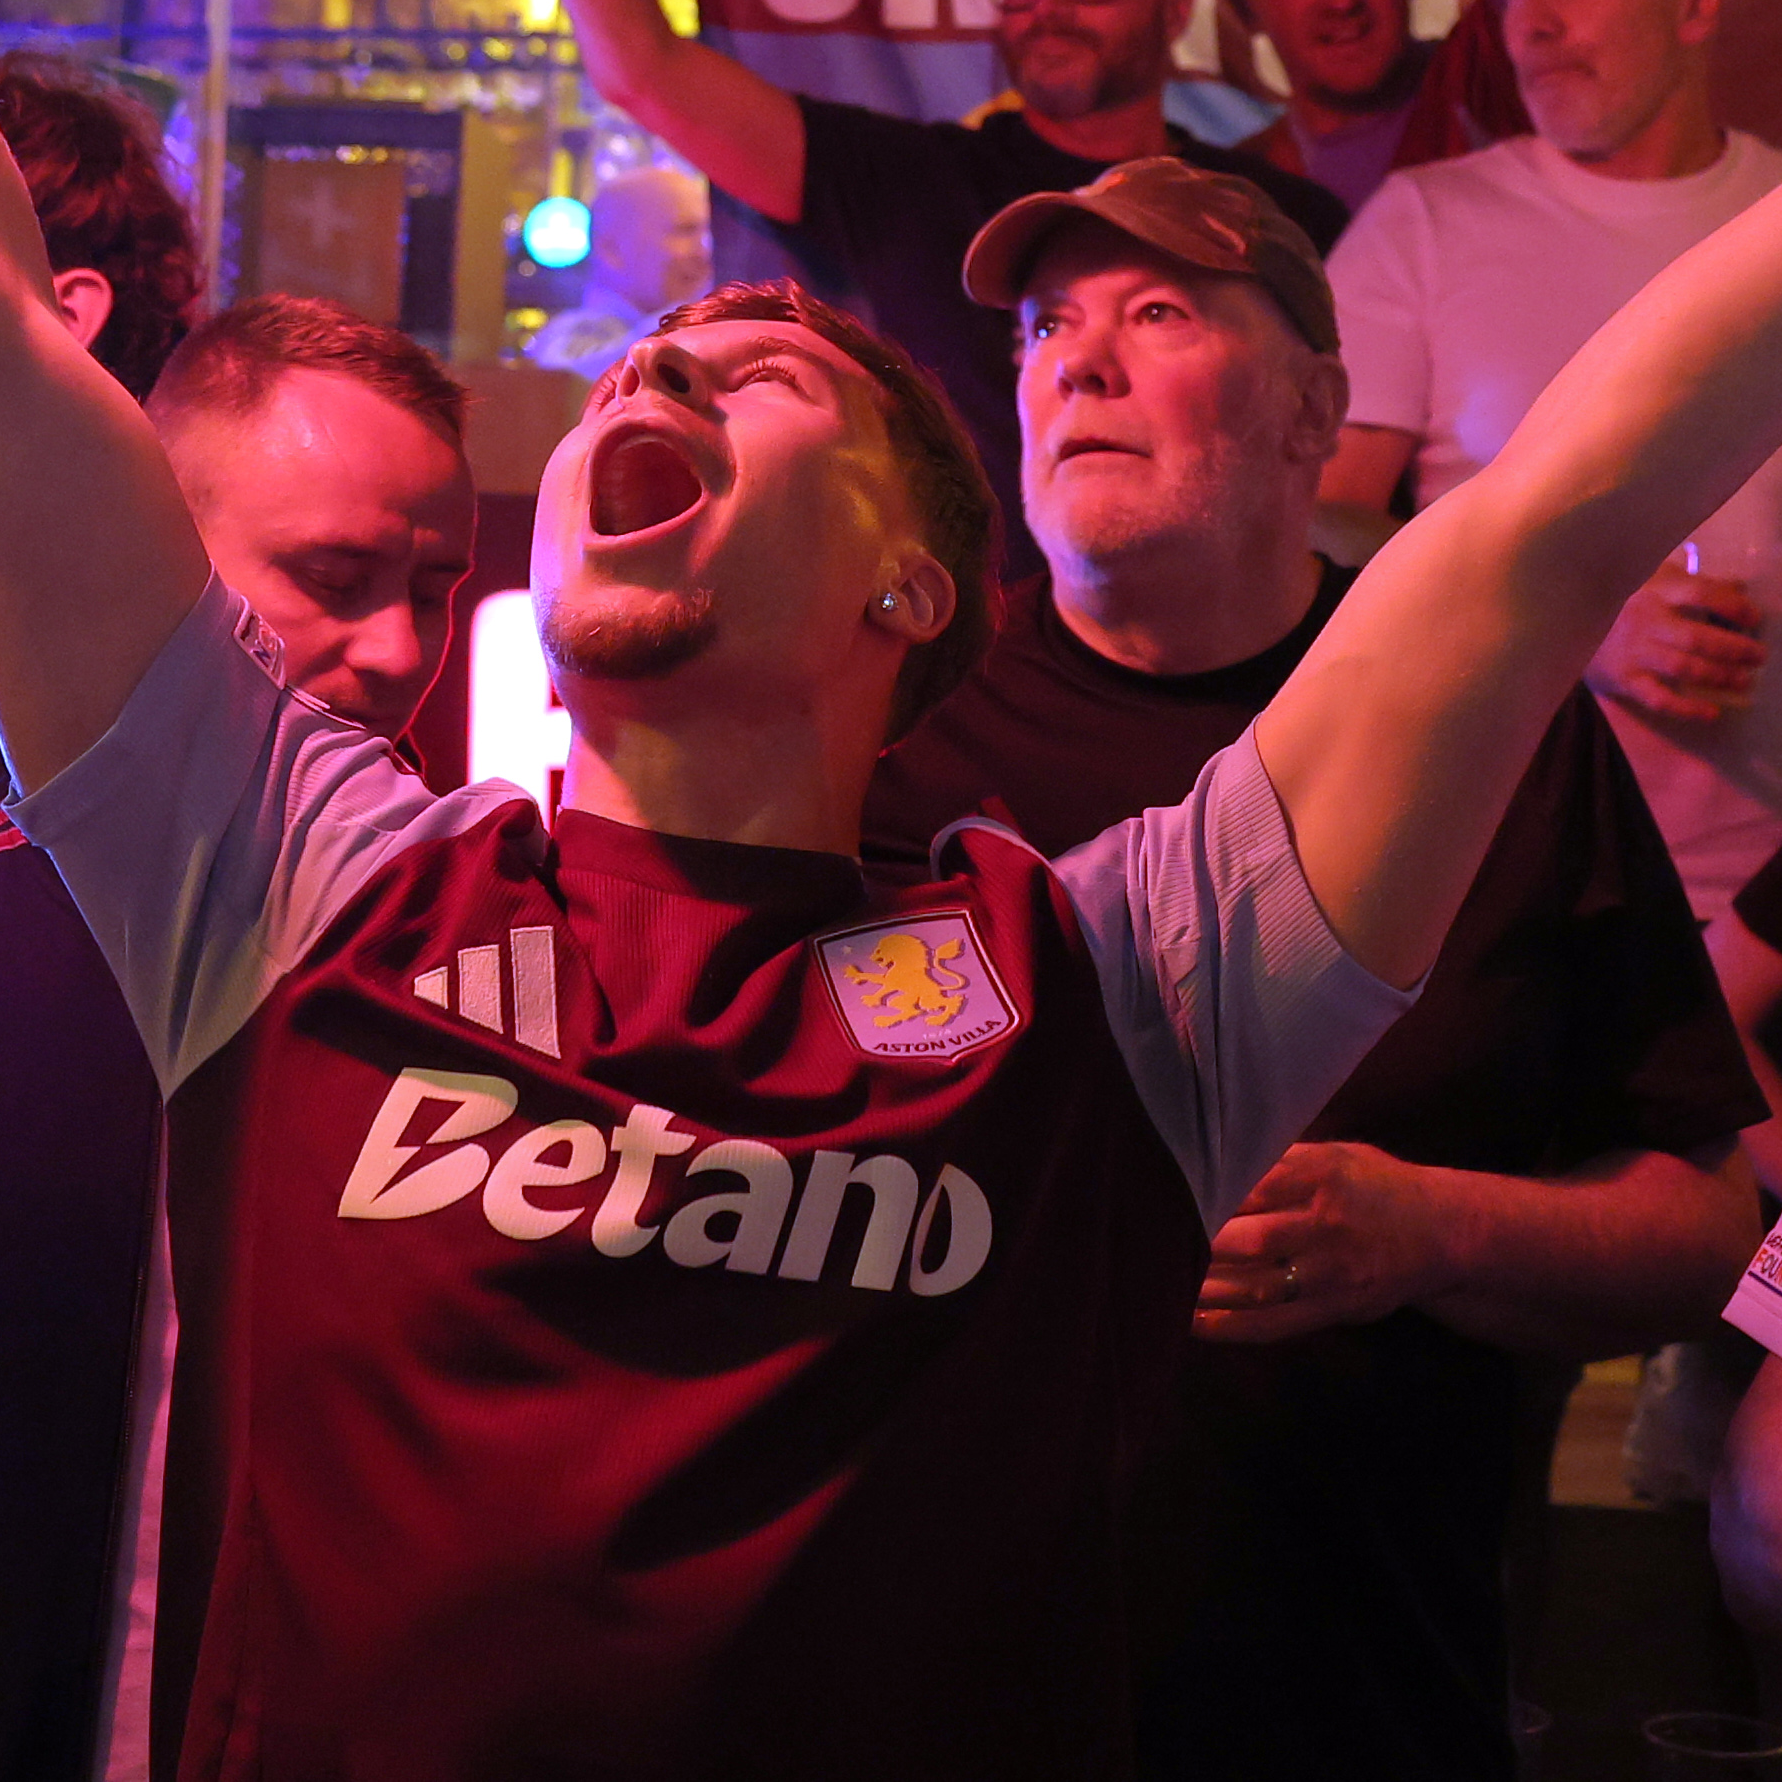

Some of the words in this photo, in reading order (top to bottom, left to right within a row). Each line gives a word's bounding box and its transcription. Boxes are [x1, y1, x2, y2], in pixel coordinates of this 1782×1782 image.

[873, 1039, 946, 1054] ASTON
[949, 1019, 1002, 1046] VILLA
[337, 1066, 993, 1298] Betano
